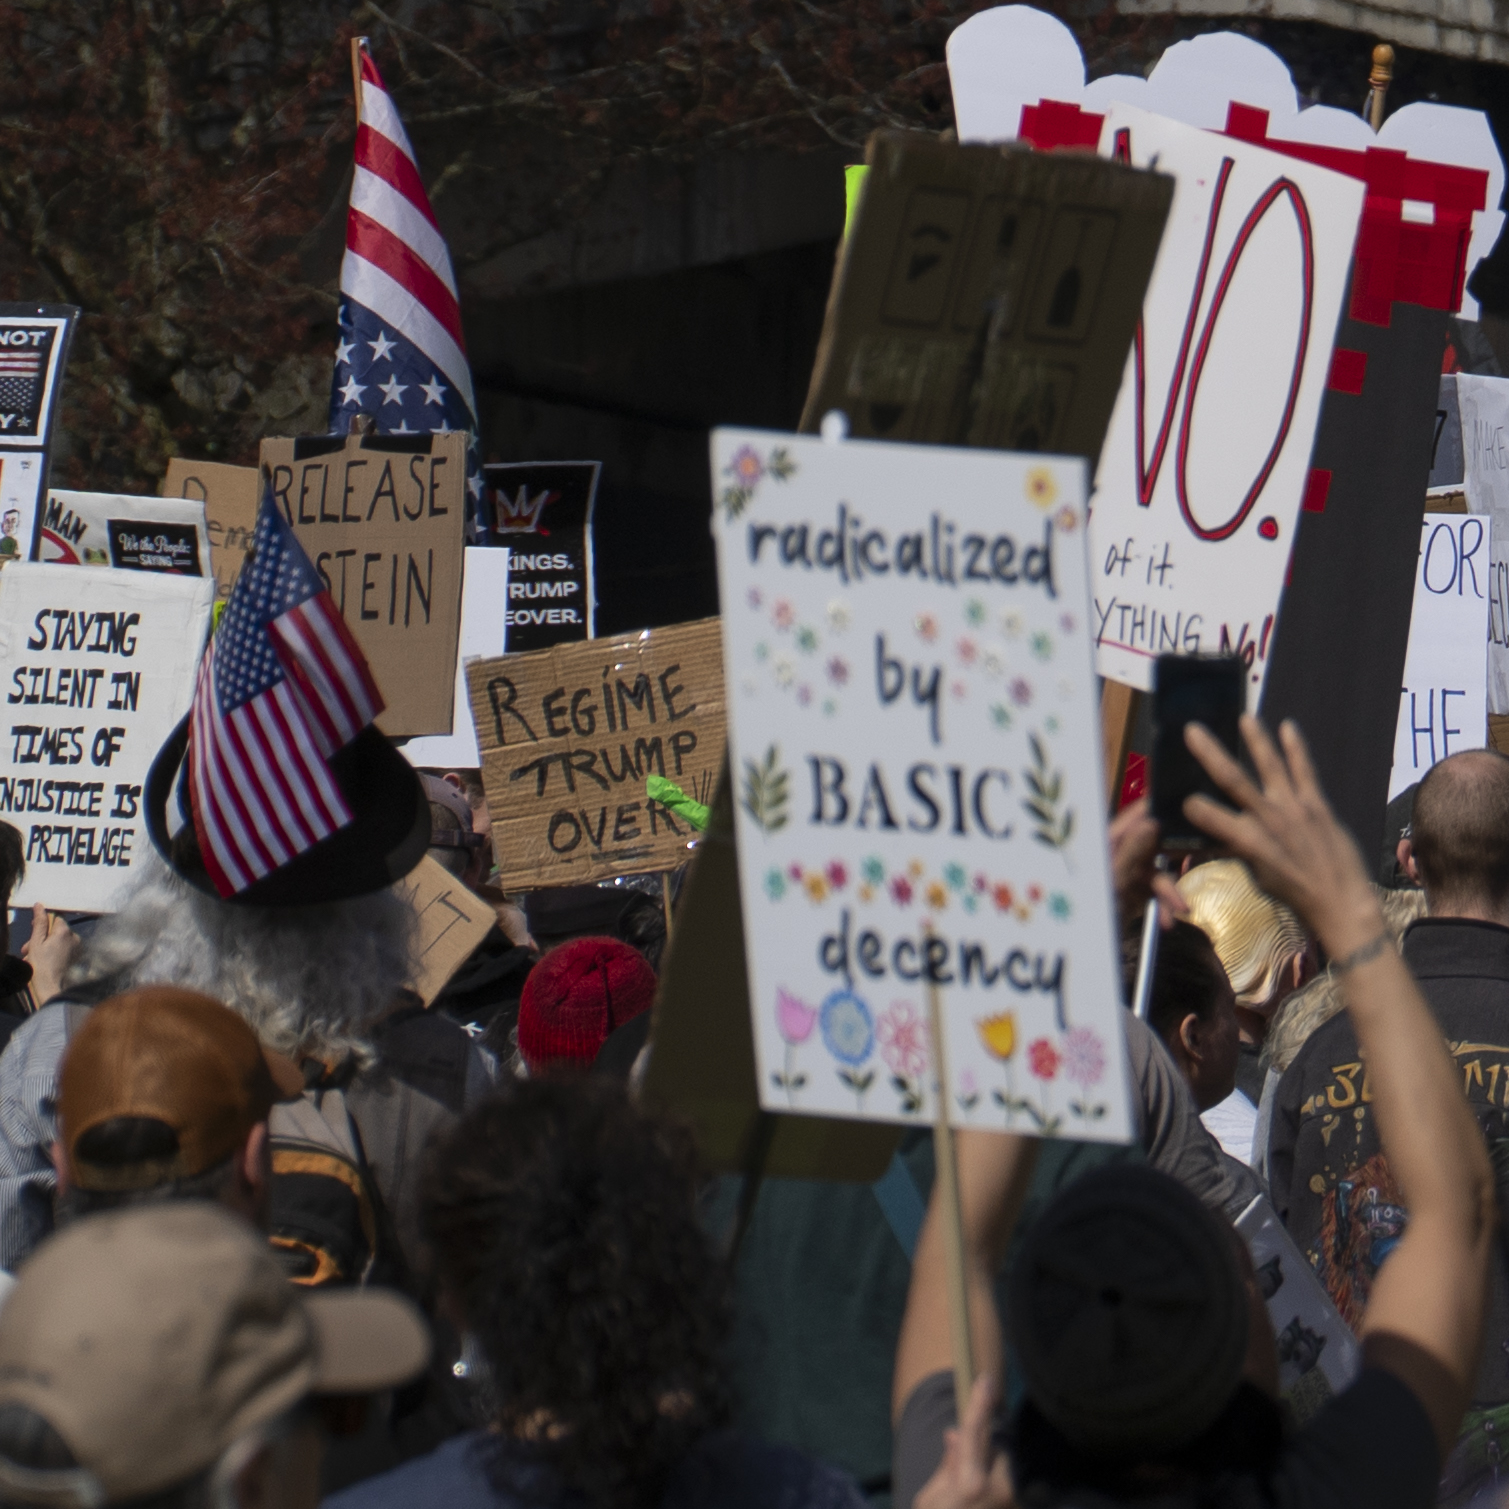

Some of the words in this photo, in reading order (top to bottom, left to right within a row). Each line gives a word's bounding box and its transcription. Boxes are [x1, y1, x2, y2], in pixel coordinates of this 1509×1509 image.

[272, 455, 449, 526] RELEASE
[506, 553, 574, 571] INGS.
[746, 503, 1060, 597] radicalized
[1102, 538, 1133, 577] of
[1420, 519, 1484, 599] OR
[506, 581, 579, 599] RUMP
[27, 609, 141, 657] STAYING
[1094, 597, 1203, 652] YTHING
[8, 667, 105, 708] SILENT
[107, 671, 141, 711] IN
[487, 663, 698, 745] REGIME
[875, 633, 943, 743] by
[11, 725, 84, 765] TIMES
[91, 727, 126, 767] OF
[1401, 686, 1466, 768] HE
[510, 730, 698, 797] TRUMP
[111, 784, 142, 819] IS
[808, 754, 1016, 839] BASIC
[26, 825, 135, 867] PRIVELAGE
[819, 909, 1069, 1028] decency
